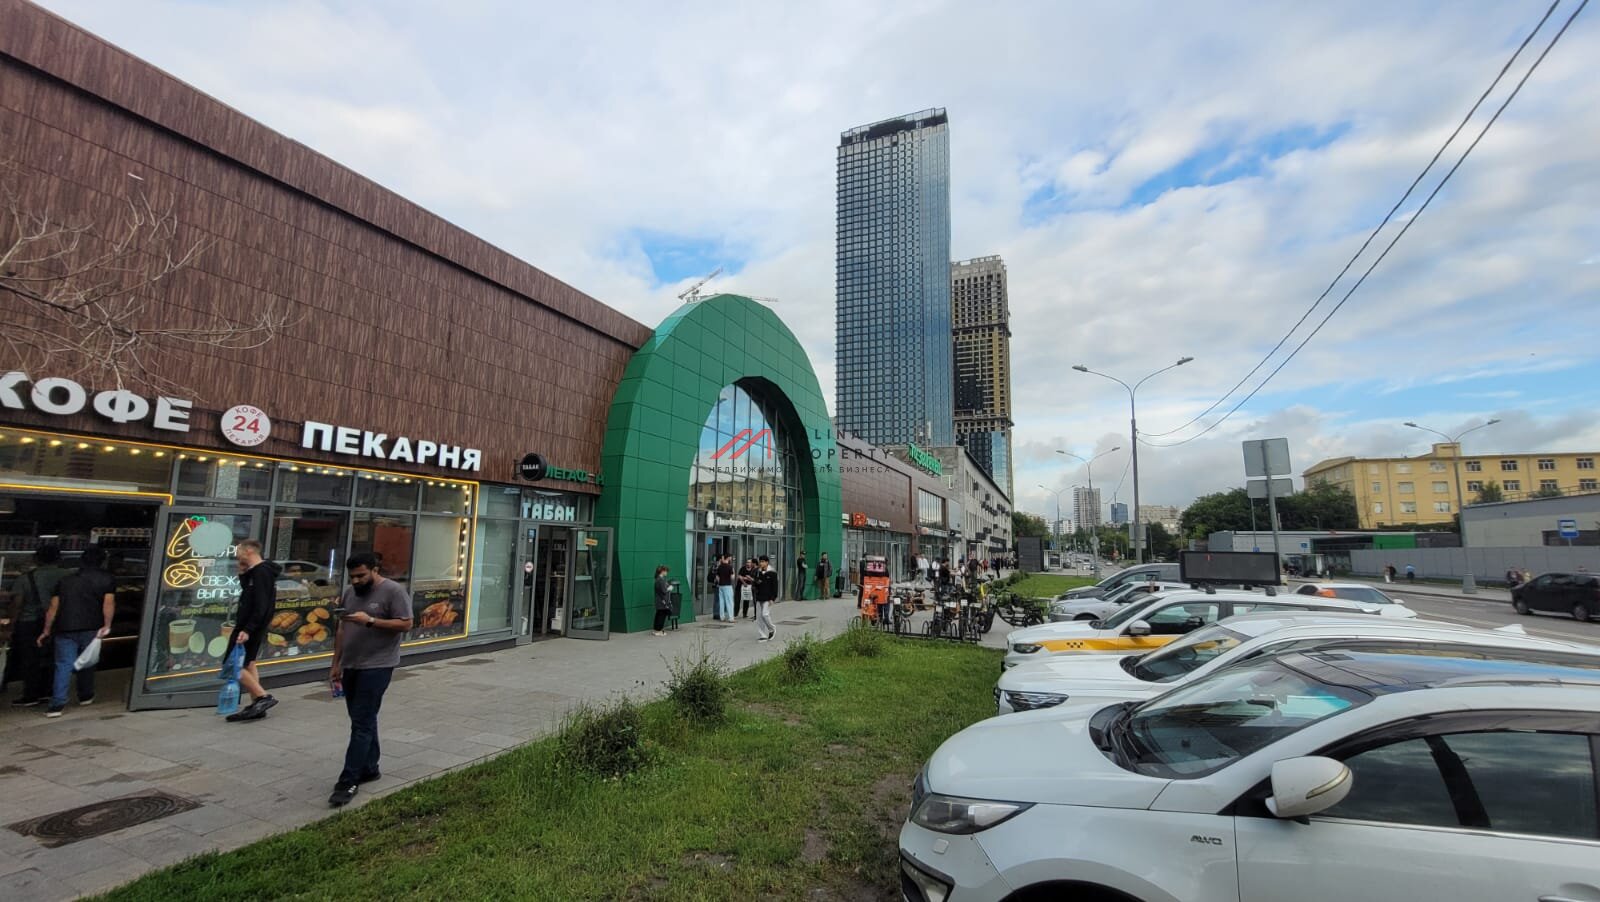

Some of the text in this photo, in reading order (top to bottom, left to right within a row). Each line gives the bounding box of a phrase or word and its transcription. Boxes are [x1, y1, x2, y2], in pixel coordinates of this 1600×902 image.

[235, 406, 263, 417] КОФЕ
[232, 415, 260, 433] 24
[302, 420, 482, 471] ПЕКАРНЯ
[522, 502, 576, 521] ТАБАК
[200, 575, 241, 587] СВЕЖ
